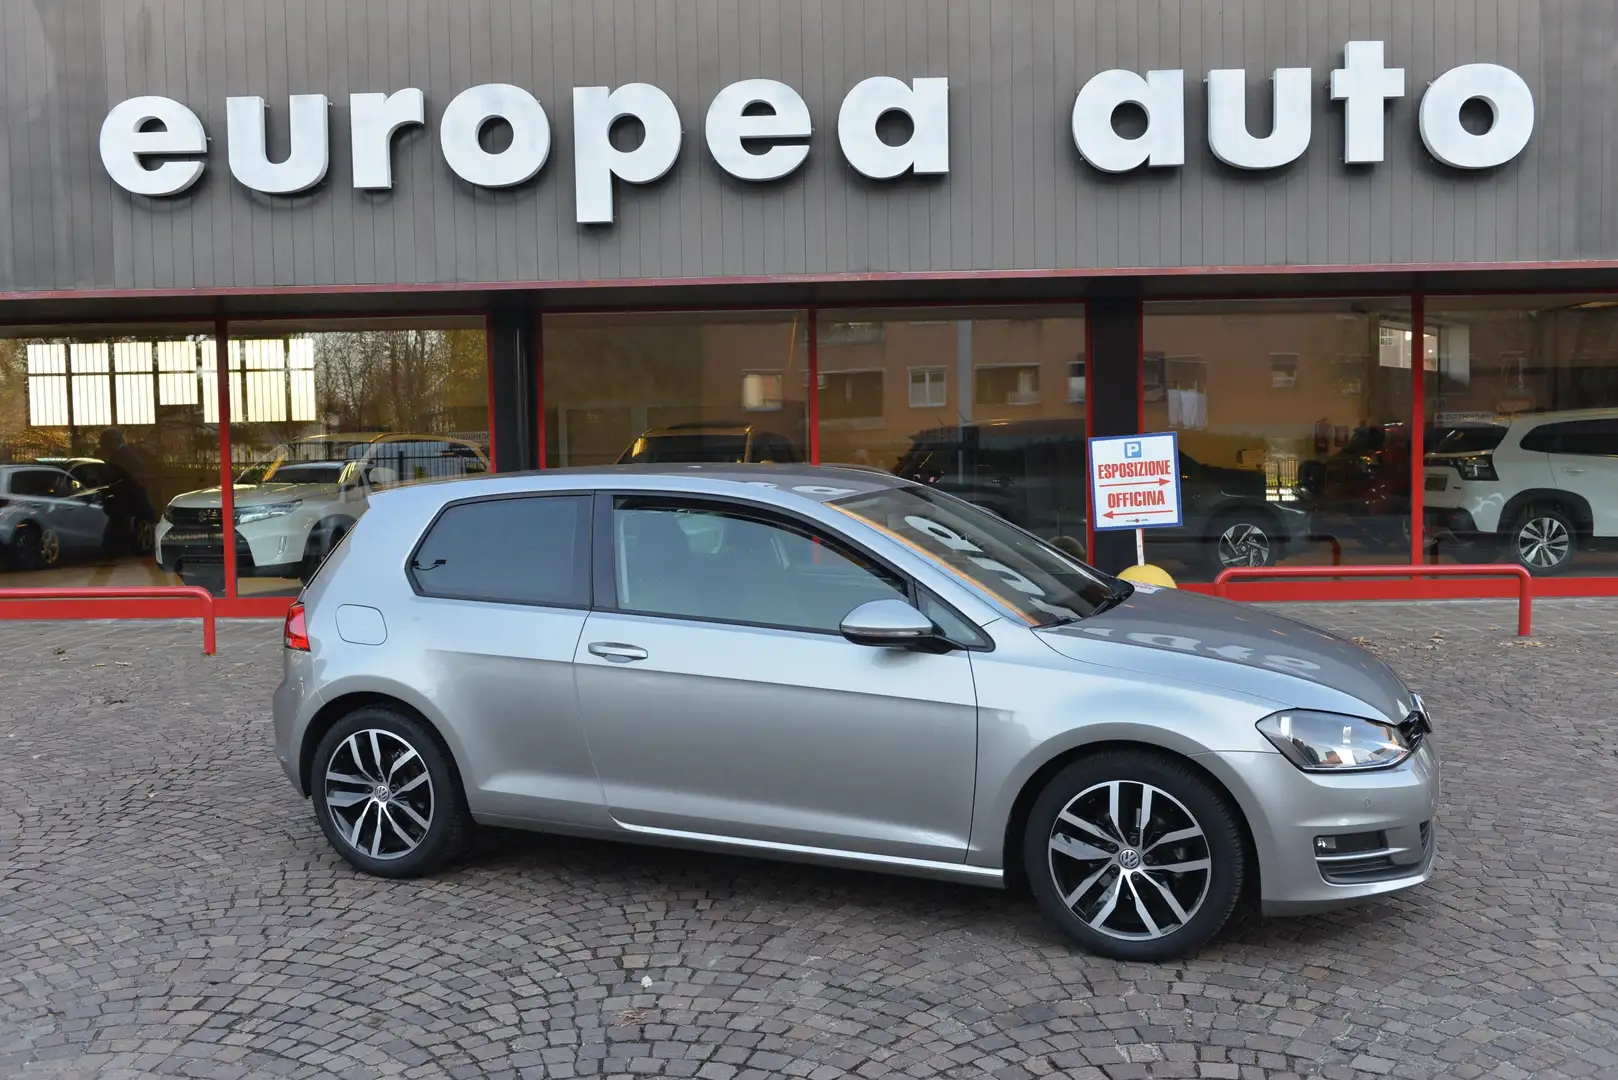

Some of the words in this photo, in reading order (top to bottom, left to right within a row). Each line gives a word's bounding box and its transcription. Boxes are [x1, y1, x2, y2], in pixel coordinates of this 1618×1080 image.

[99, 77, 950, 224] europea
[1072, 41, 1535, 173] auto
[1126, 443, 1140, 457] P
[1098, 460, 1171, 479] ESPOSIZIONE
[1107, 490, 1165, 508] OFFICINA
